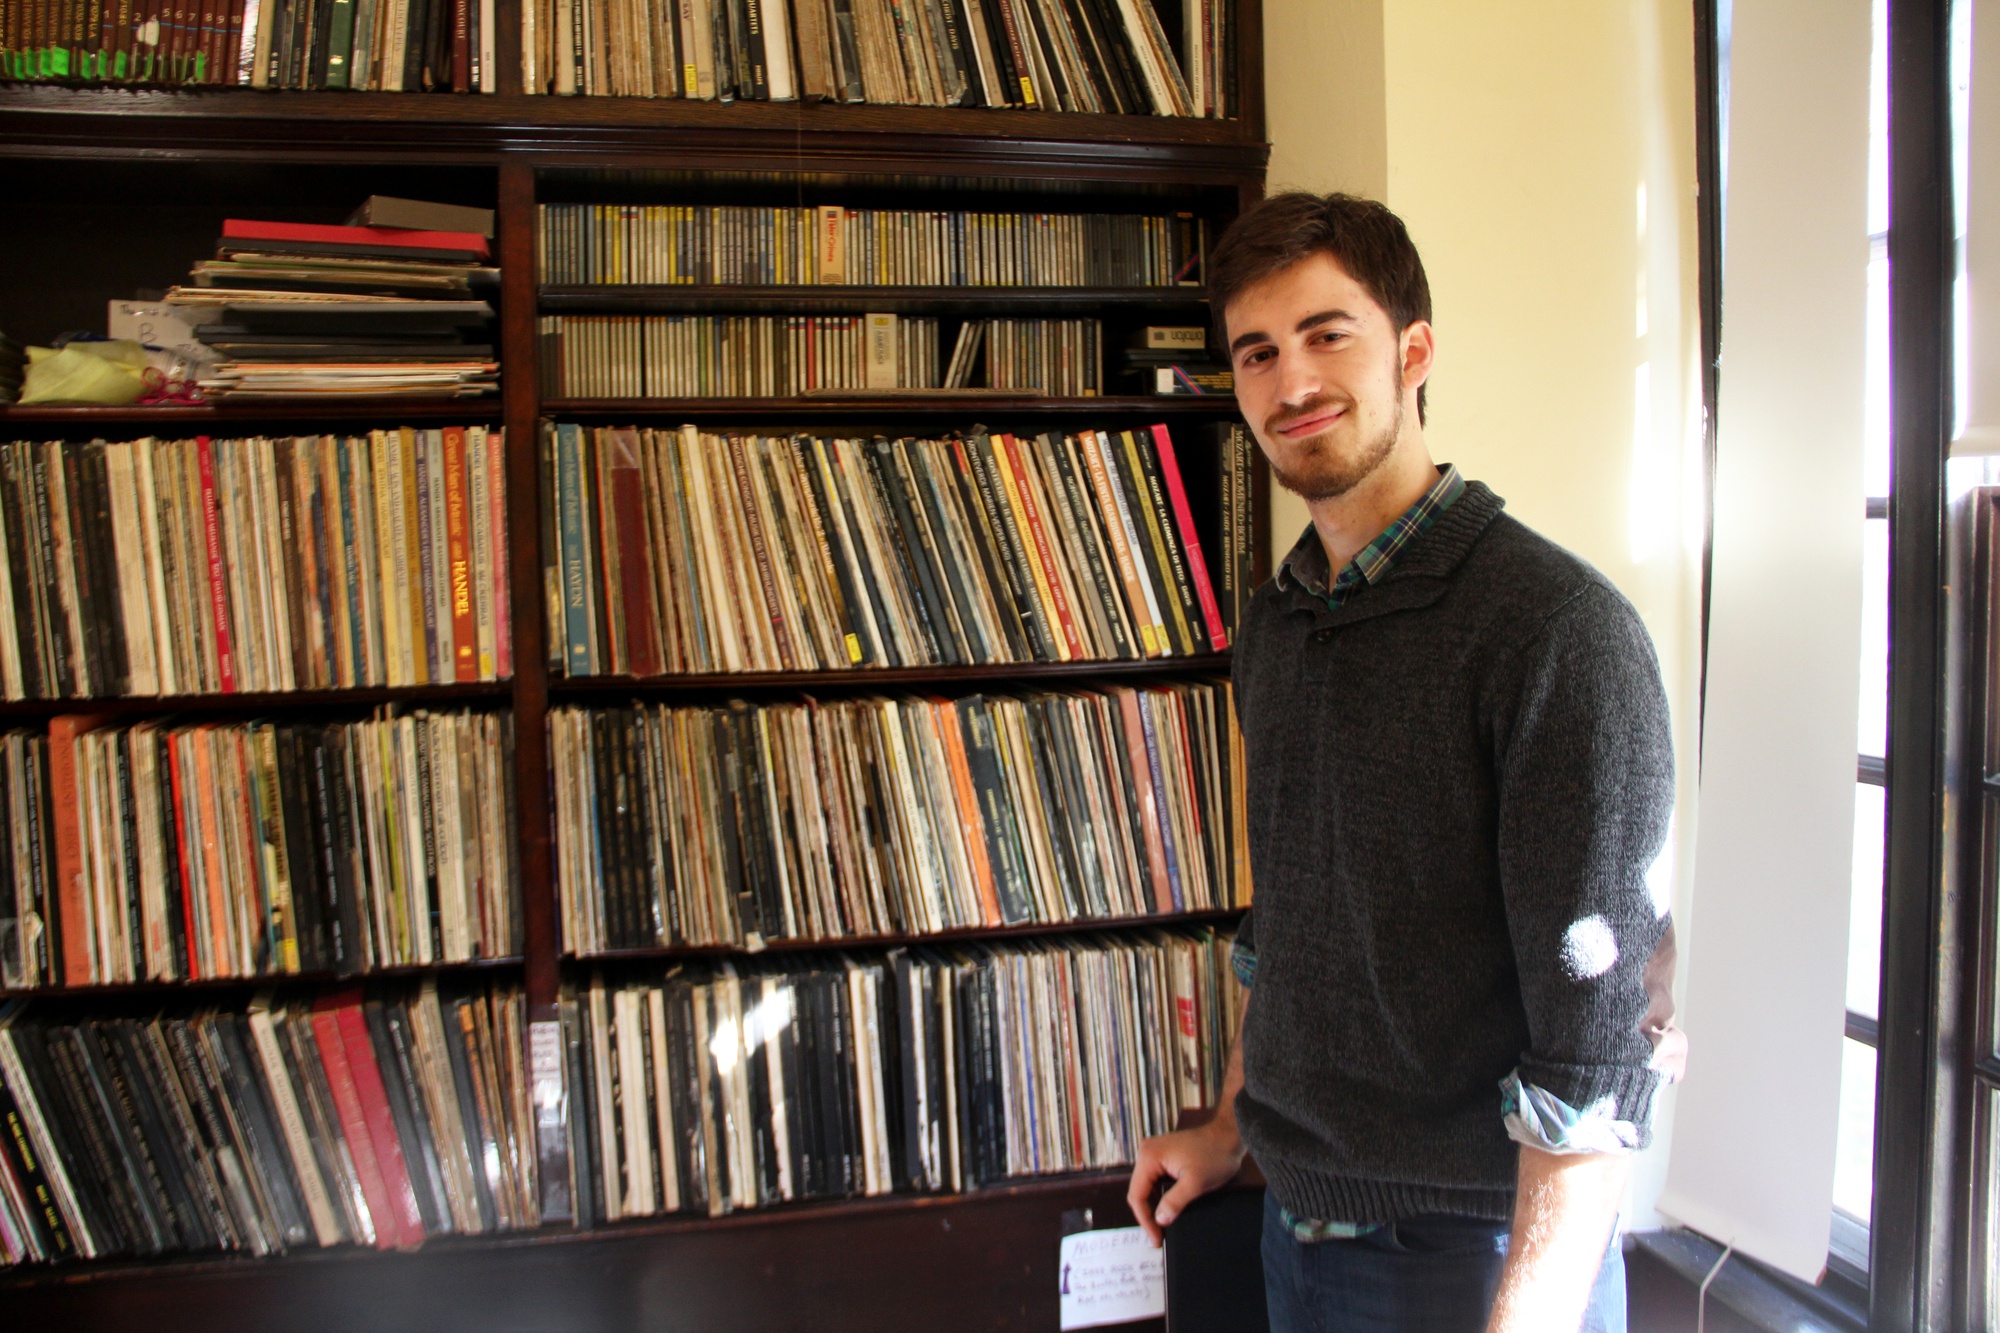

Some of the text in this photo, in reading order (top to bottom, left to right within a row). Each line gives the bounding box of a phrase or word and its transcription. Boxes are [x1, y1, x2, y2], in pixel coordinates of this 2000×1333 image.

[103, 10, 110, 18] 1
[133, 13, 141, 22] 2
[163, 8, 170, 17] 5
[175, 10, 182, 19] 6
[188, 13, 195, 22] 7
[138, 322, 157, 344] B
[446, 433, 464, 536] Great Men of Music
[564, 487, 577, 501] of
[565, 501, 578, 534] Music
[1083, 435, 1100, 468] MOZART
[1097, 481, 1111, 503] FINTA
[1104, 502, 1126, 553] GIARDINIERA
[1120, 554, 1135, 582] HAGER
[1149, 474, 1164, 505] MOZART
[1161, 517, 1177, 554] CLEMENZA
[1174, 564, 1185, 580] TITO
[1180, 584, 1192, 606] DAVIS
[451, 560, 469, 616] HANDEL
[568, 558, 582, 607] HAYDN
[1073, 1232, 1140, 1258] MODERN
